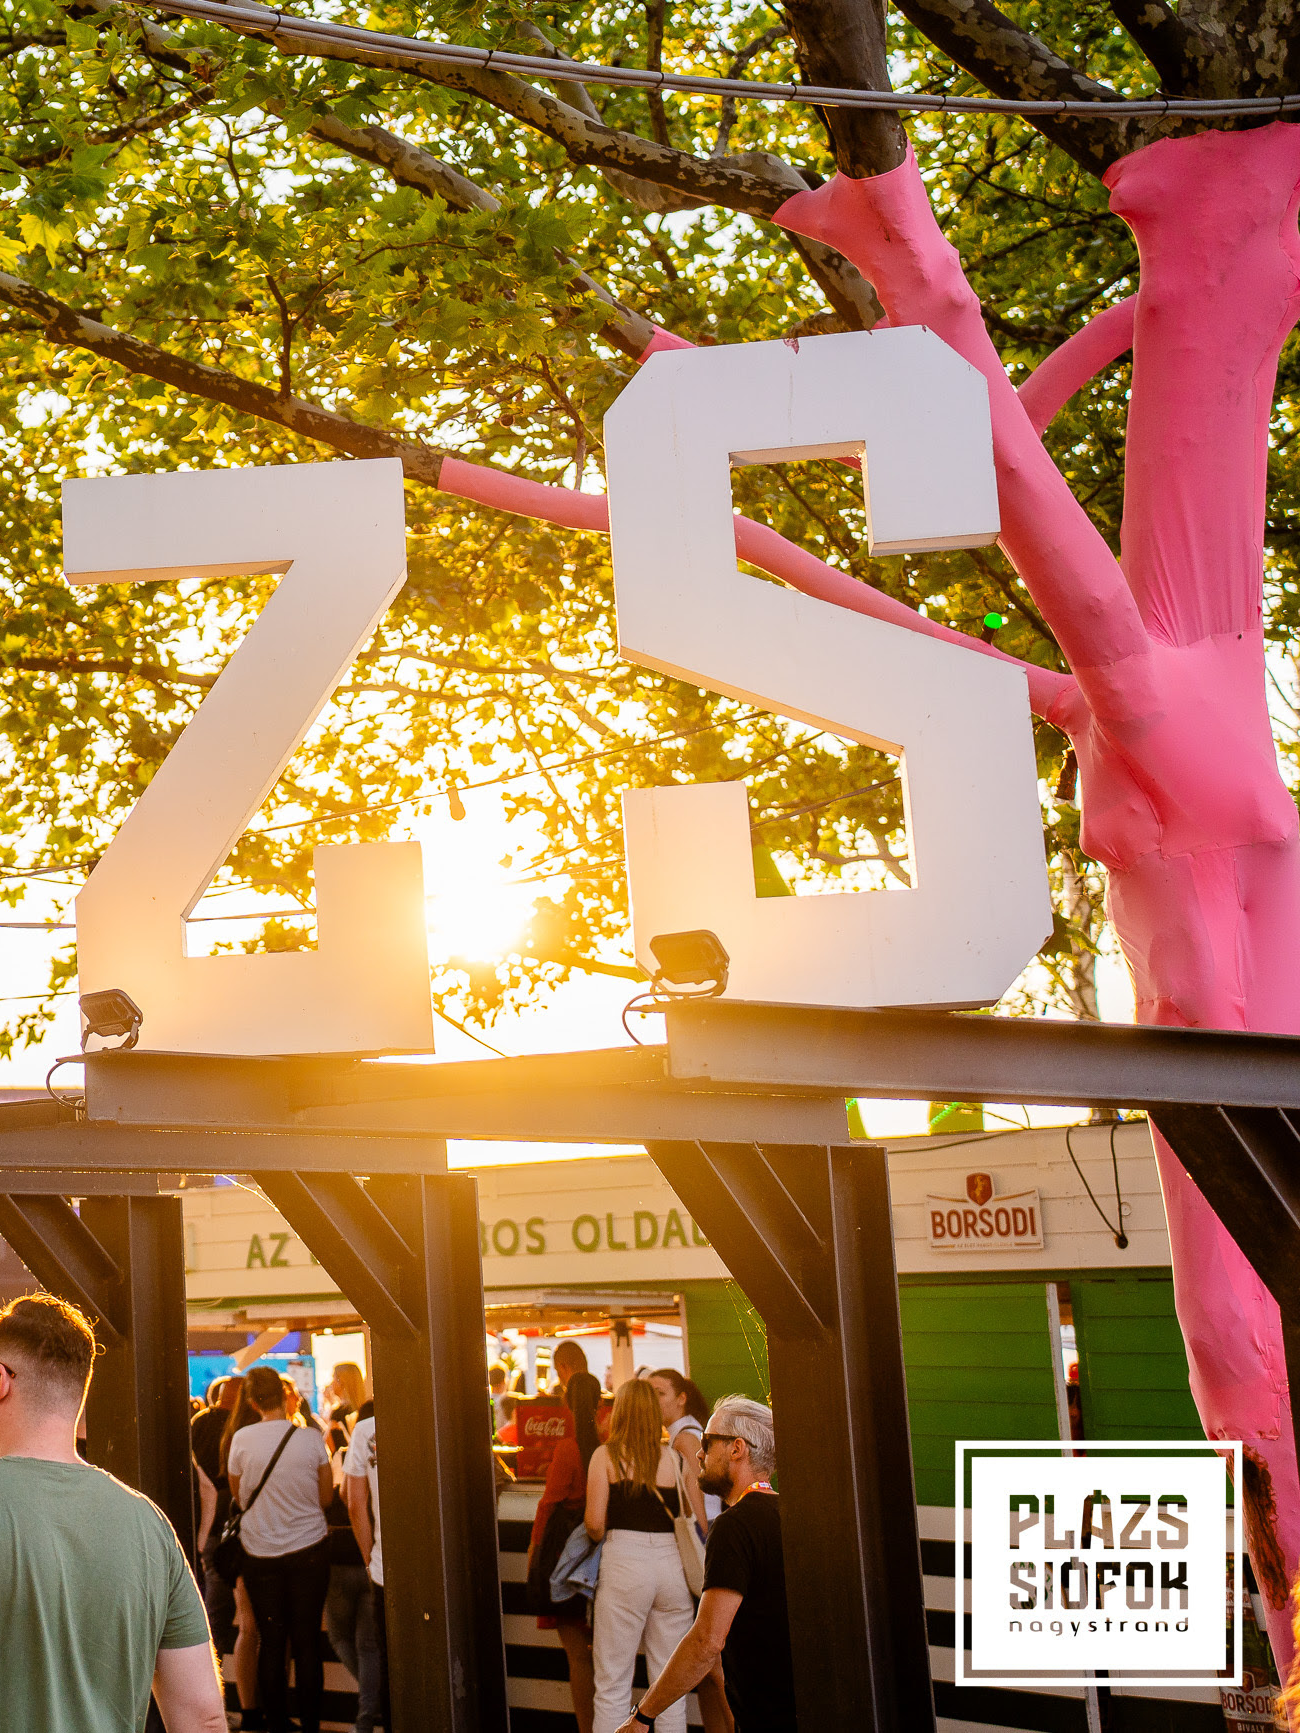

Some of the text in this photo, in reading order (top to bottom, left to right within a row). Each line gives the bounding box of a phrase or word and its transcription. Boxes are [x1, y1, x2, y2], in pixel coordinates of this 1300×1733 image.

[930, 1206, 1038, 1239] BORSODI
[246, 1232, 289, 1269] AZ
[1221, 1692, 1273, 1714] BORSOD
